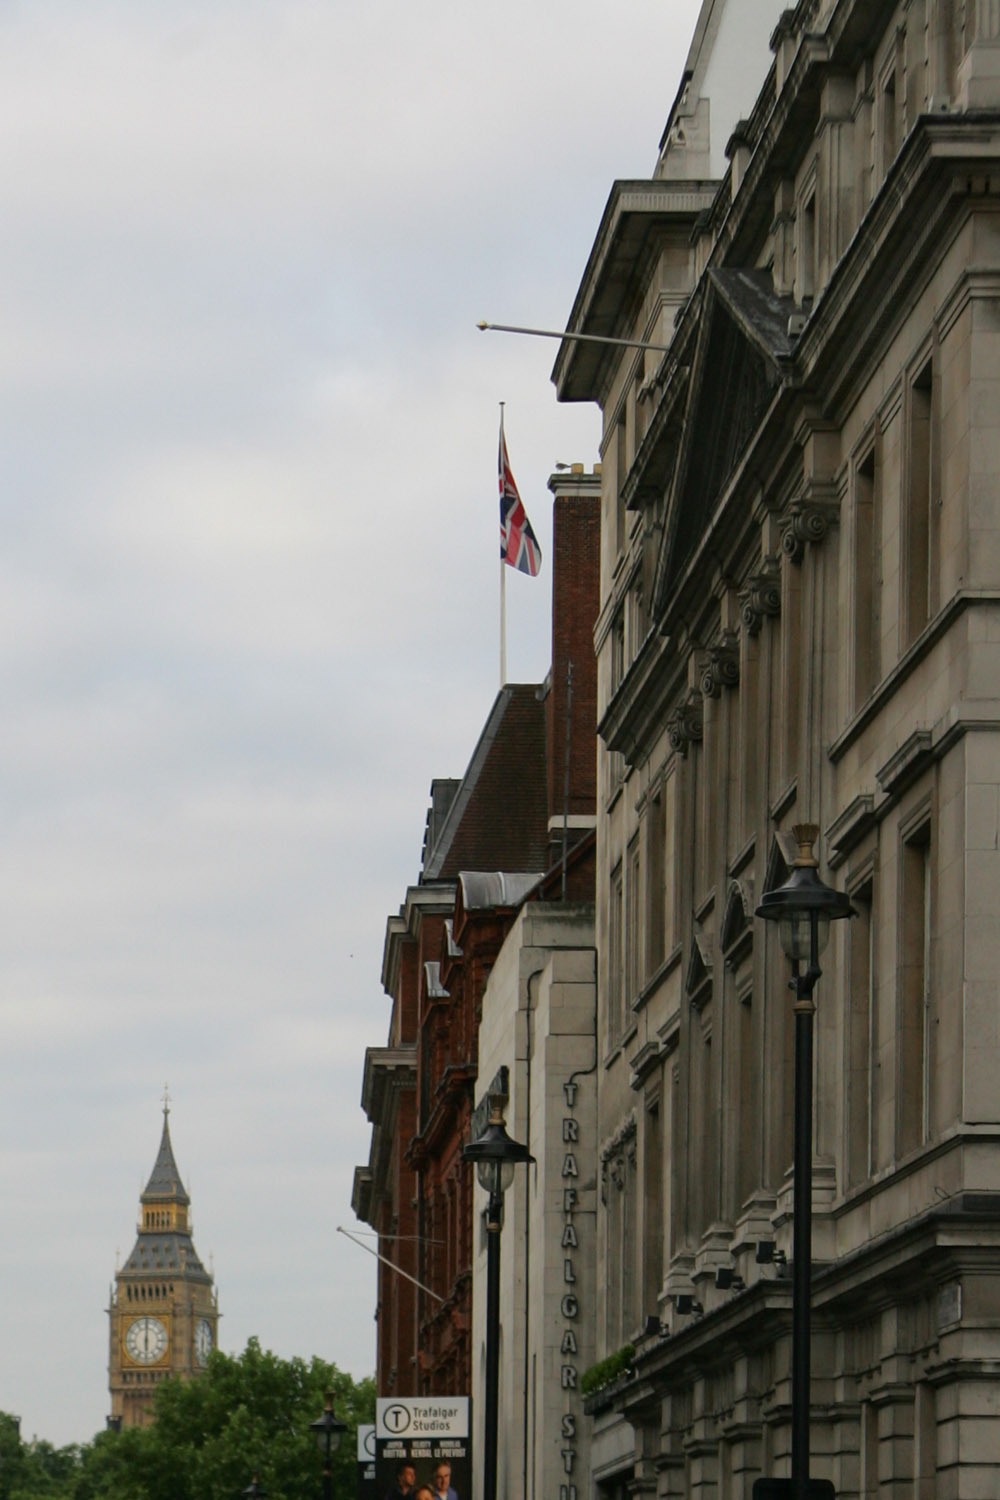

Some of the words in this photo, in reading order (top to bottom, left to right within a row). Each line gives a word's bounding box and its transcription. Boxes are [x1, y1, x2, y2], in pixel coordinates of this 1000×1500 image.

[561, 1083, 579, 1389] TRAFALGAR
[413, 1407, 458, 1418] Trafalgar
[413, 1421, 450, 1431] Studios
